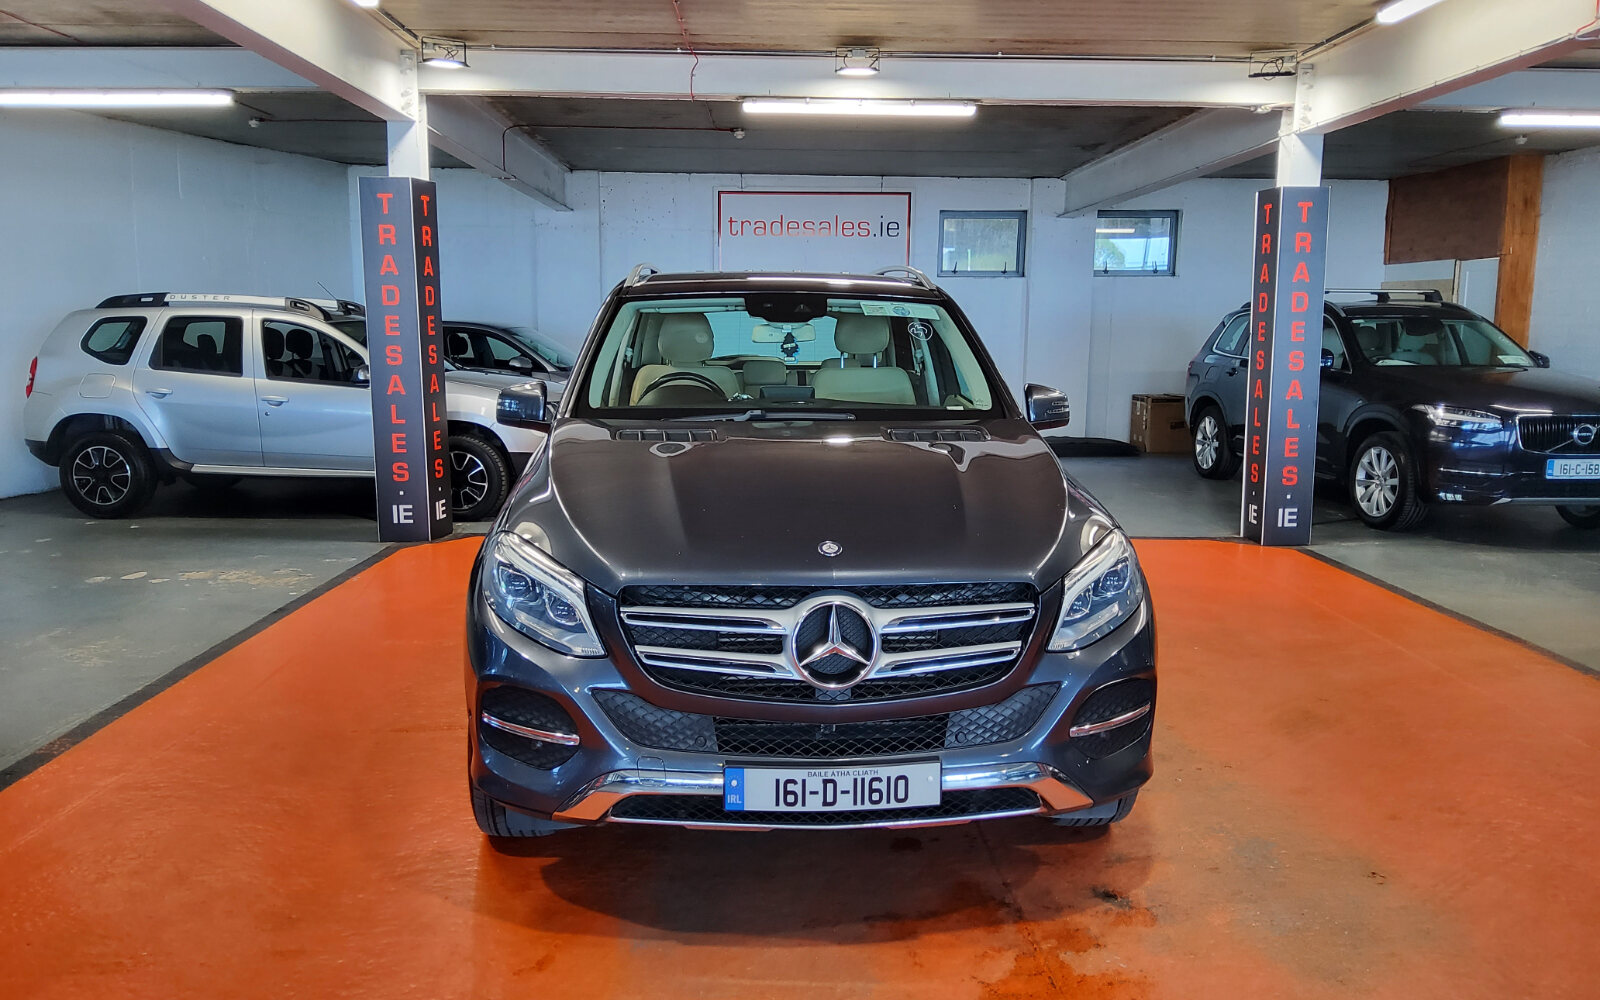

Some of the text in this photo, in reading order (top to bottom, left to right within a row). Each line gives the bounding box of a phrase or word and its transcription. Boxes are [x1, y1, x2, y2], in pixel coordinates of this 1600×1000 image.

[727, 214, 901, 238] tradesales.ie
[807, 768, 879, 778] BAILE ÁTHA CLIATH
[727, 794, 742, 804] IRL
[774, 774, 909, 807] 161-D-11610
